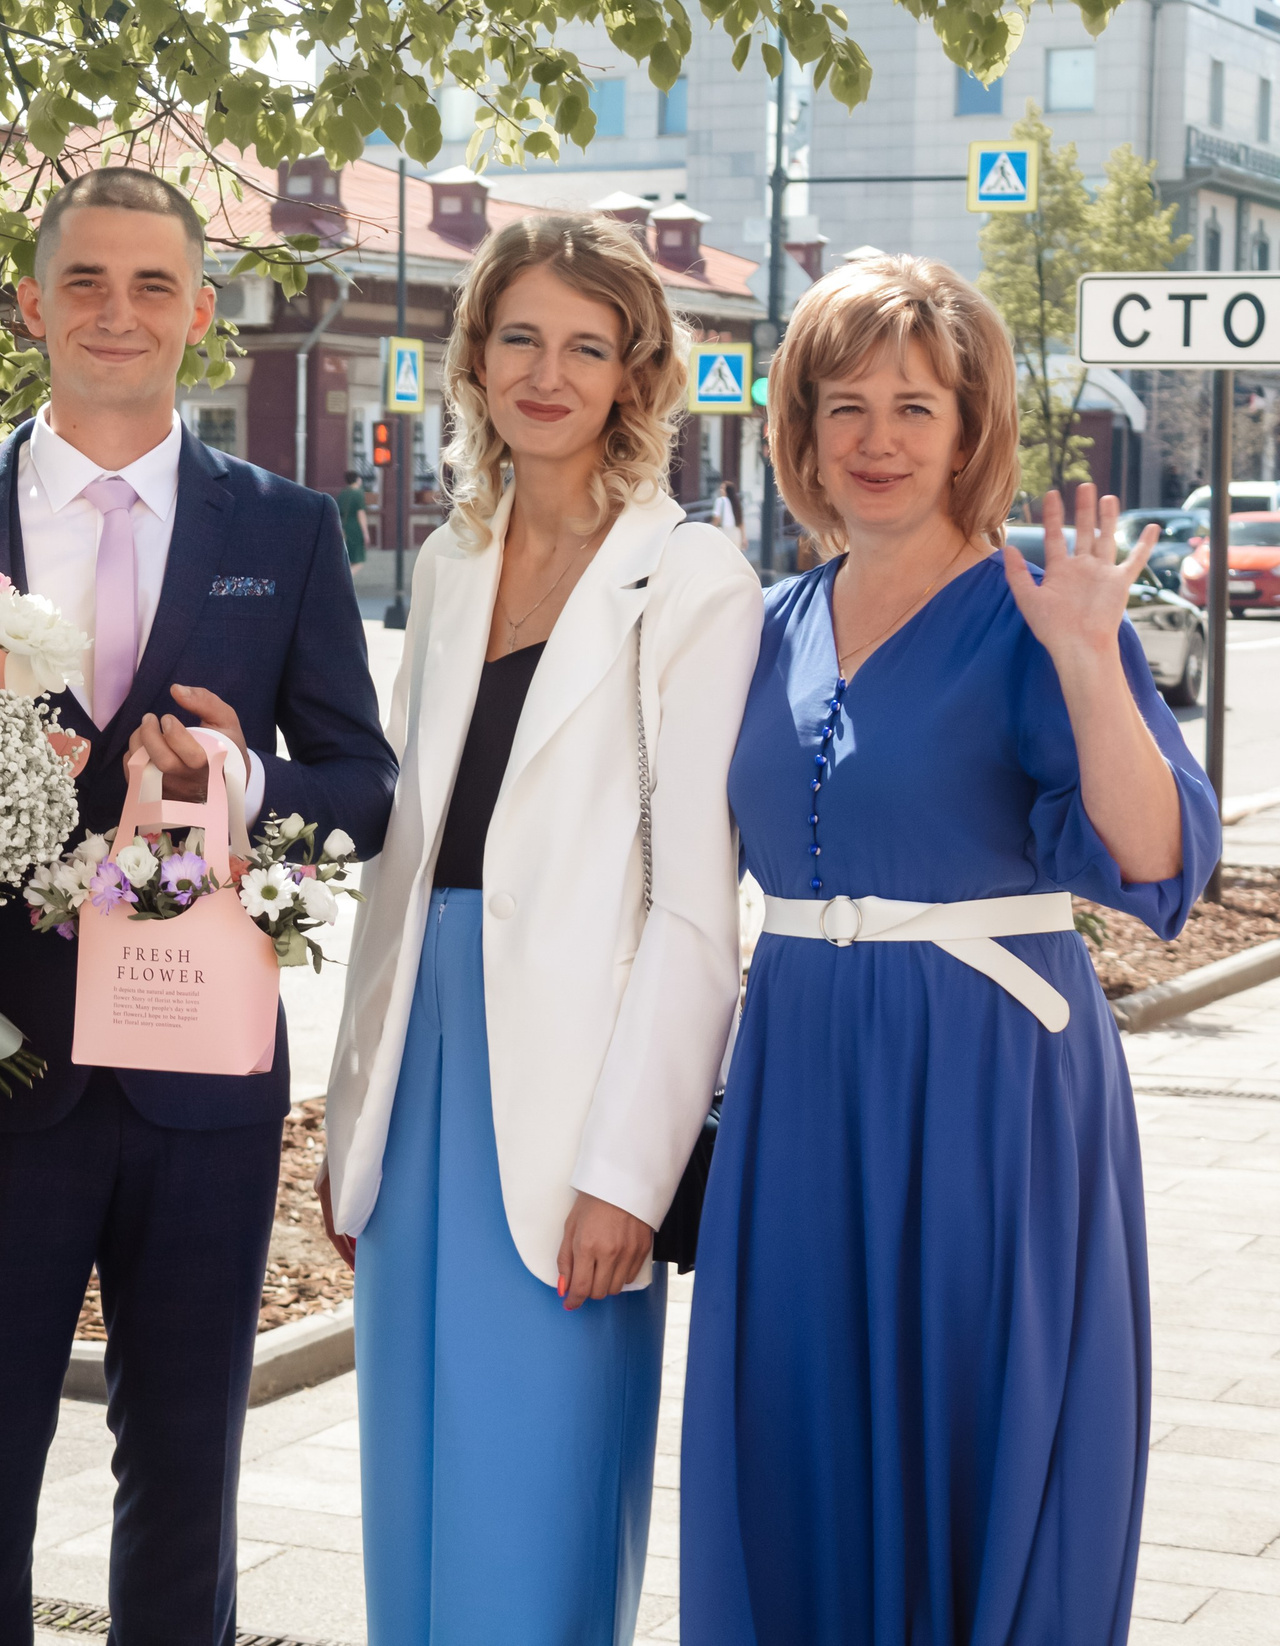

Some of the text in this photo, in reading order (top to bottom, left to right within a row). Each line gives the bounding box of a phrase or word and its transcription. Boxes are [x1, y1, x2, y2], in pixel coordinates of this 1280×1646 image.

[122, 946, 191, 963] FRESH
[116, 965, 206, 984] FLOWER
[135, 1003, 150, 1011] Many
